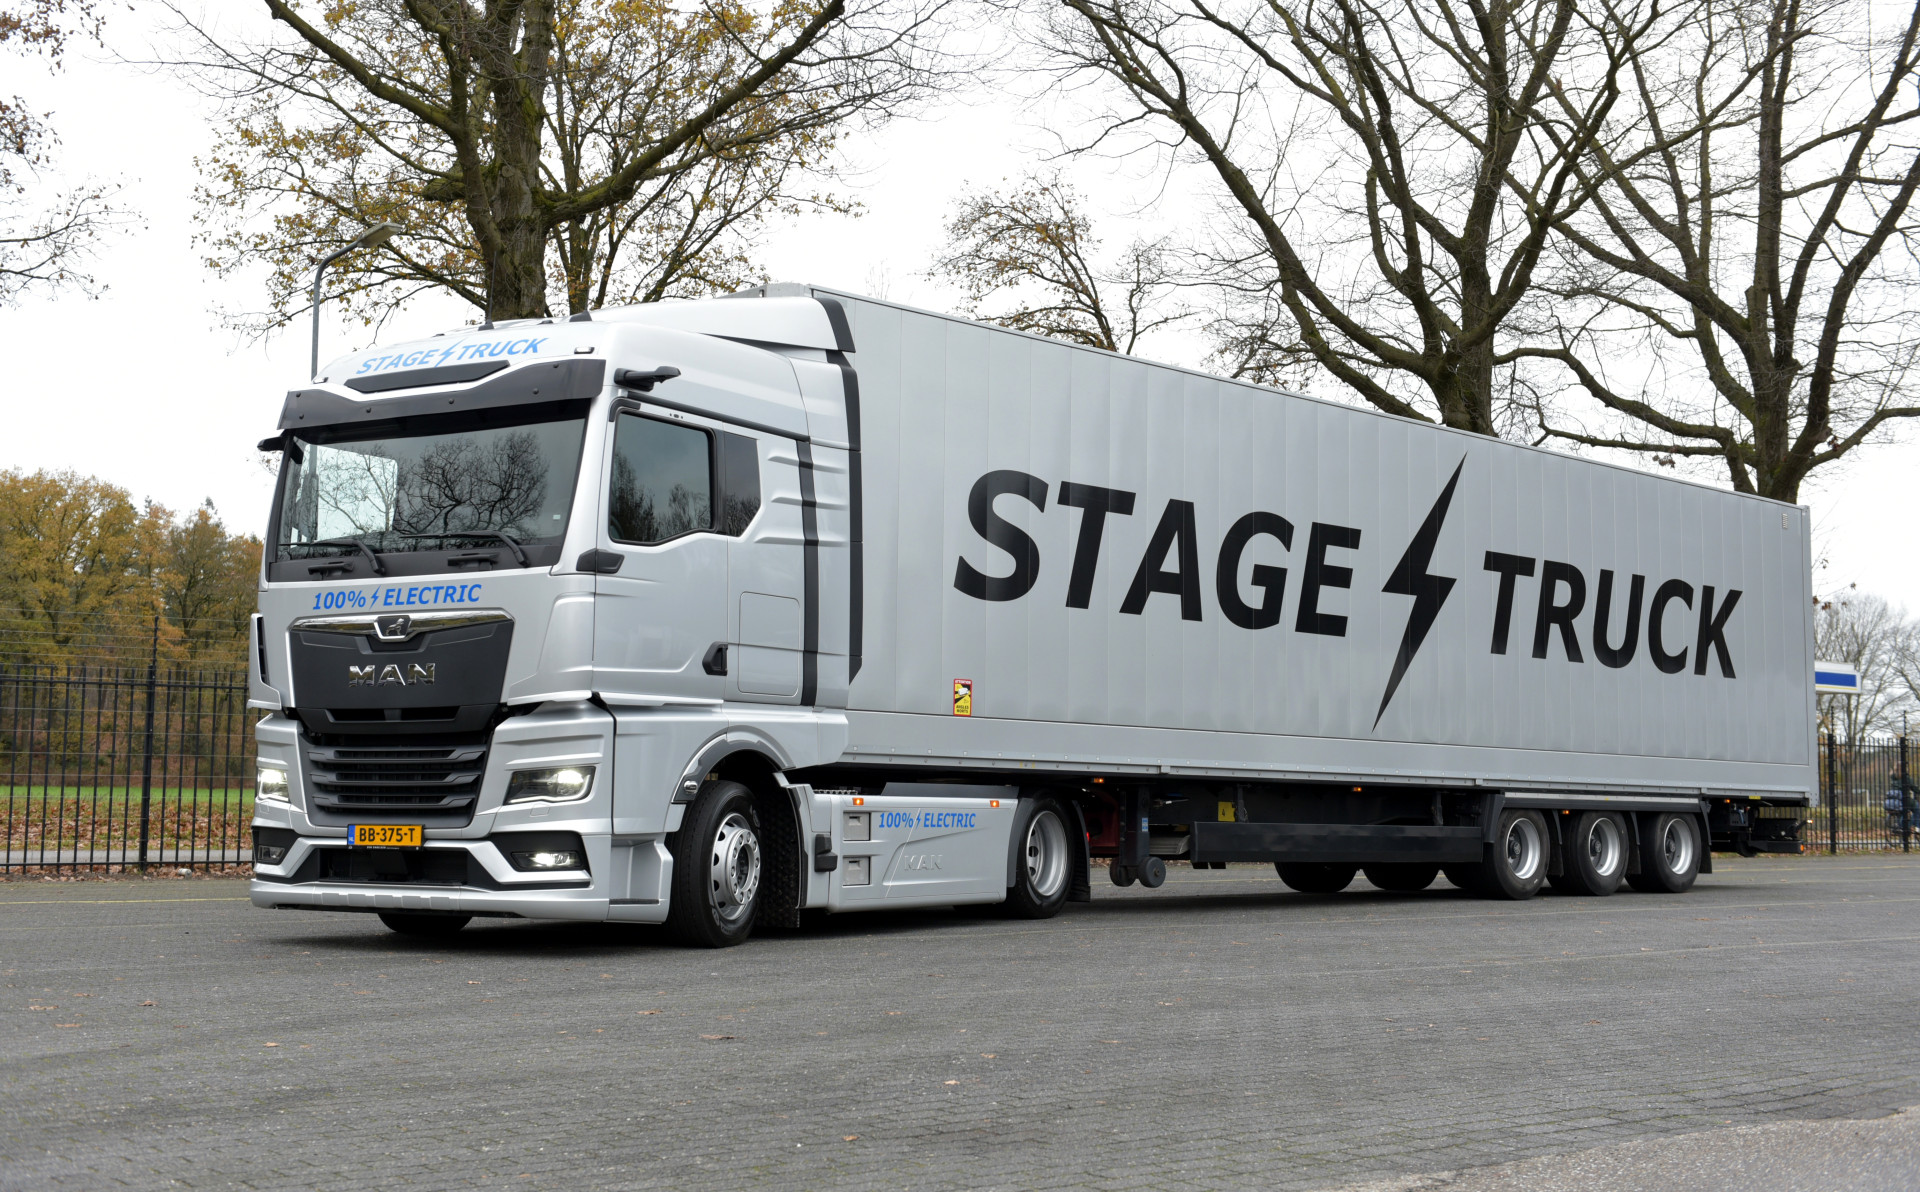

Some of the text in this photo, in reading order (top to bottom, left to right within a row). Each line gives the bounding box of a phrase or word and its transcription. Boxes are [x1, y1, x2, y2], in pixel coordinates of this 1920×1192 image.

[356, 337, 549, 374] STAGE TRUCK
[953, 469, 1743, 679] STAGE TRUCK
[312, 584, 482, 610] 100% ELECTRIC
[348, 663, 436, 687] MAN
[879, 812, 976, 828] 100% ELECTRIC
[360, 828, 415, 842] BB-375-T
[904, 854, 943, 871] MAN
